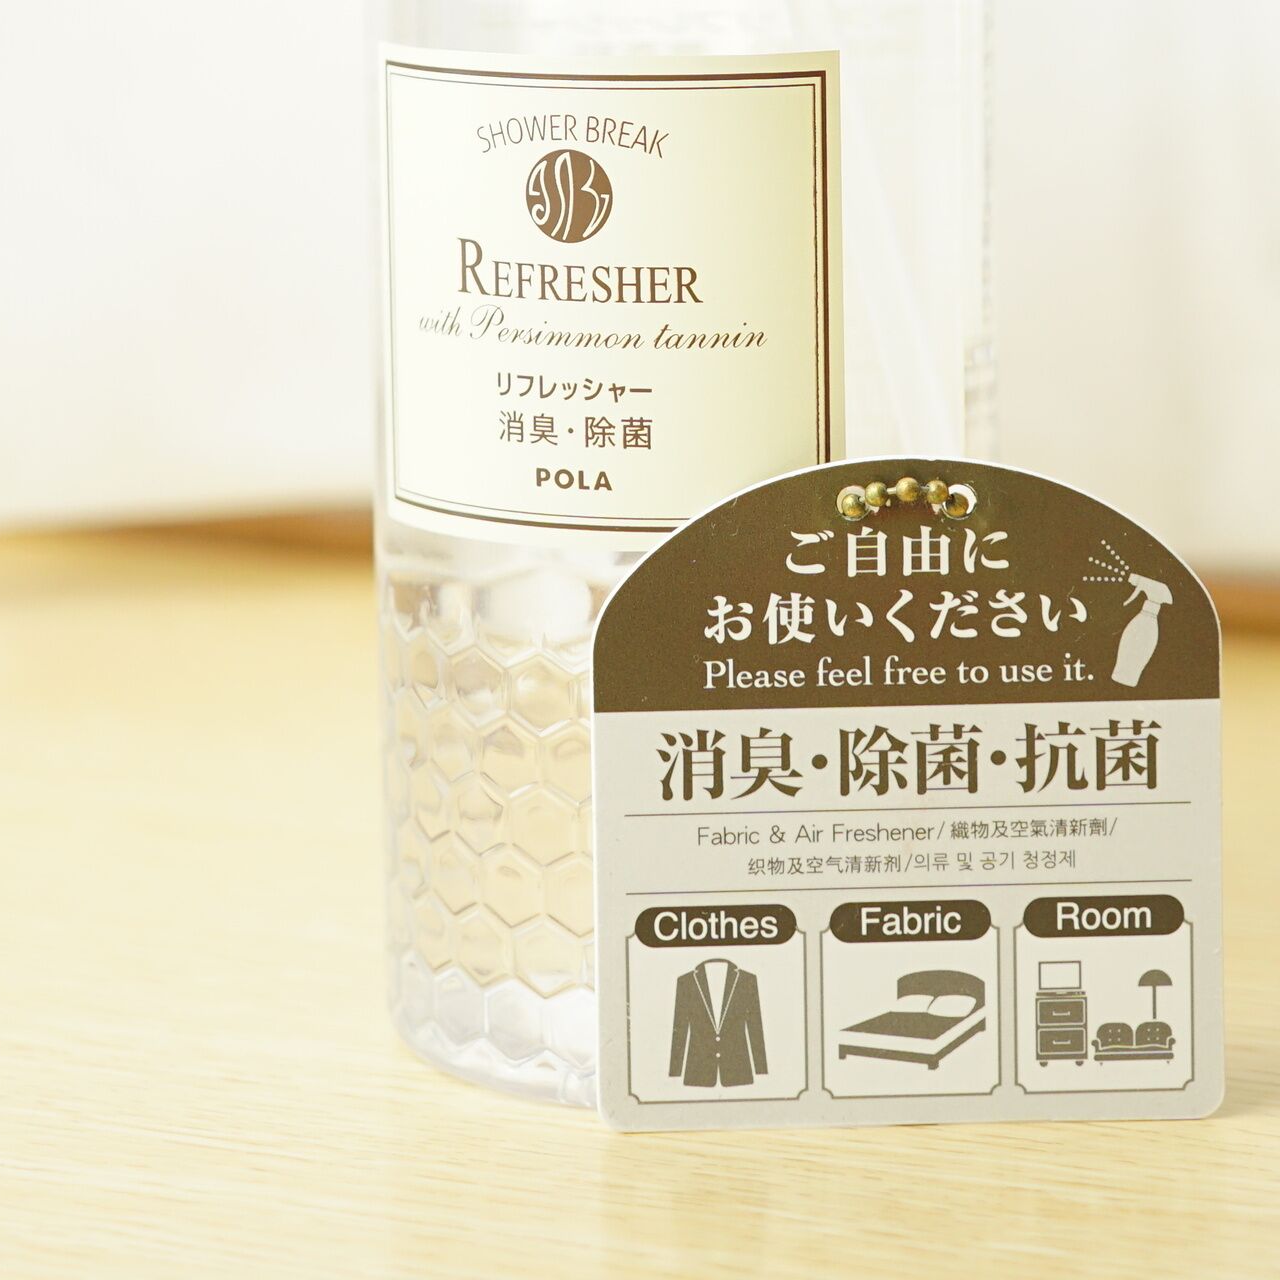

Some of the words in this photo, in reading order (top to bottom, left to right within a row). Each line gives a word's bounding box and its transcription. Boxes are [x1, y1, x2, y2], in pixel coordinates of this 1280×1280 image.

[477, 114, 577, 153] SHOWER
[586, 116, 670, 158] BREAK
[457, 237, 703, 304] REFRESHER
[419, 306, 463, 338] with
[469, 304, 645, 350] Persimmon
[653, 322, 768, 350] tannin
[497, 372, 653, 403] リフレッシャー
[536, 468, 612, 491] POLA
[785, 526, 1010, 578] ご自由に
[703, 589, 1089, 645] お使いください
[703, 659, 806, 691] Please
[816, 656, 872, 688] feel
[883, 654, 947, 686] free
[958, 659, 989, 684] to
[998, 661, 1053, 684] use
[1063, 652, 1095, 682] it.
[697, 825, 760, 846] Fabric
[769, 825, 786, 844] &
[795, 824, 823, 844] Air
[957, 851, 973, 870] 및
[980, 851, 1015, 870] 공기
[1023, 849, 1076, 869] 청정제
[653, 910, 779, 941] Clothes
[860, 906, 962, 936] Fabric
[1056, 902, 1152, 930] Room
